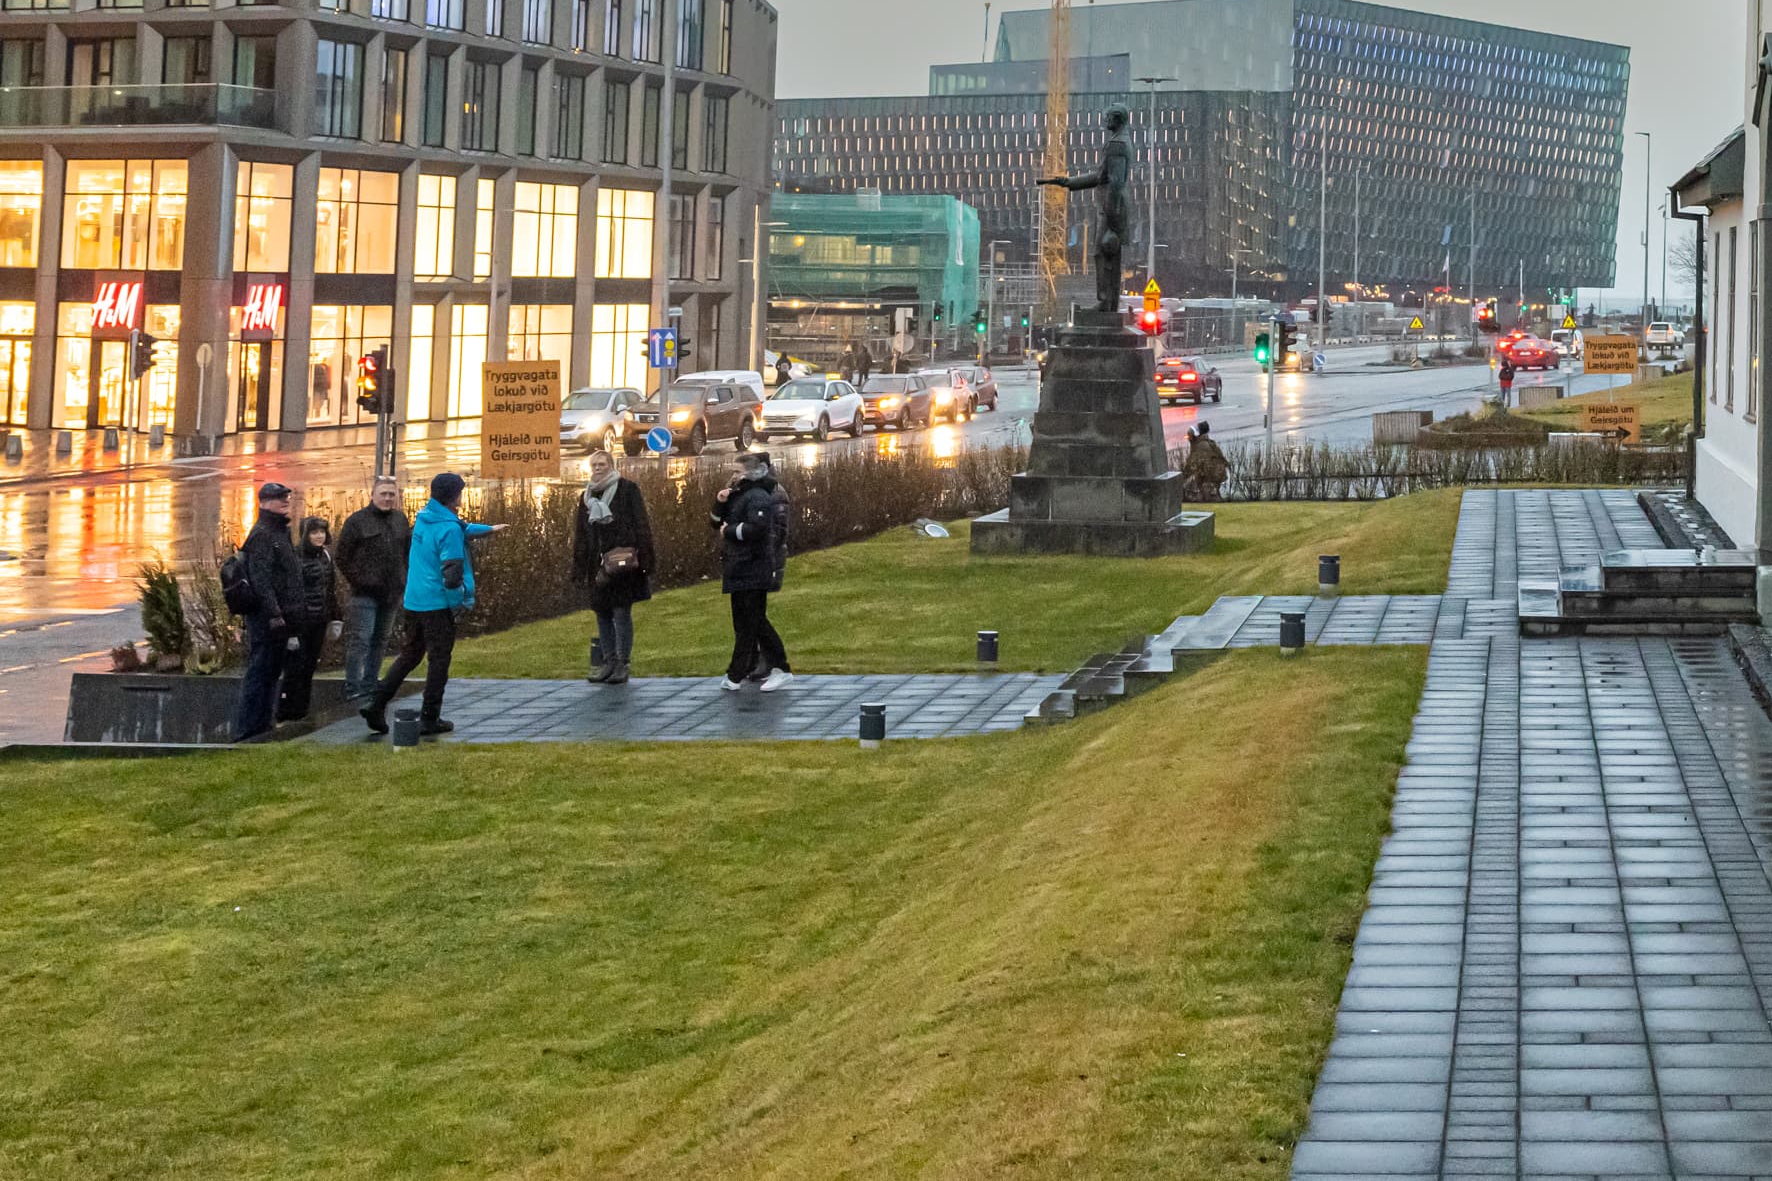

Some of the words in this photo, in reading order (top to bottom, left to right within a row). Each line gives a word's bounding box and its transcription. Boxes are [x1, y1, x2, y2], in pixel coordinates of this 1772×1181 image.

[91, 282, 142, 329] H&M
[243, 285, 282, 329] H&M
[485, 369, 558, 383] Tryggvagata
[494, 384, 527, 397] lokuð
[530, 384, 549, 396] við
[487, 401, 555, 413] Lækjargötu
[489, 434, 531, 447] Hjáleið
[534, 435, 553, 445] um
[491, 449, 551, 462] Geirsgötu
